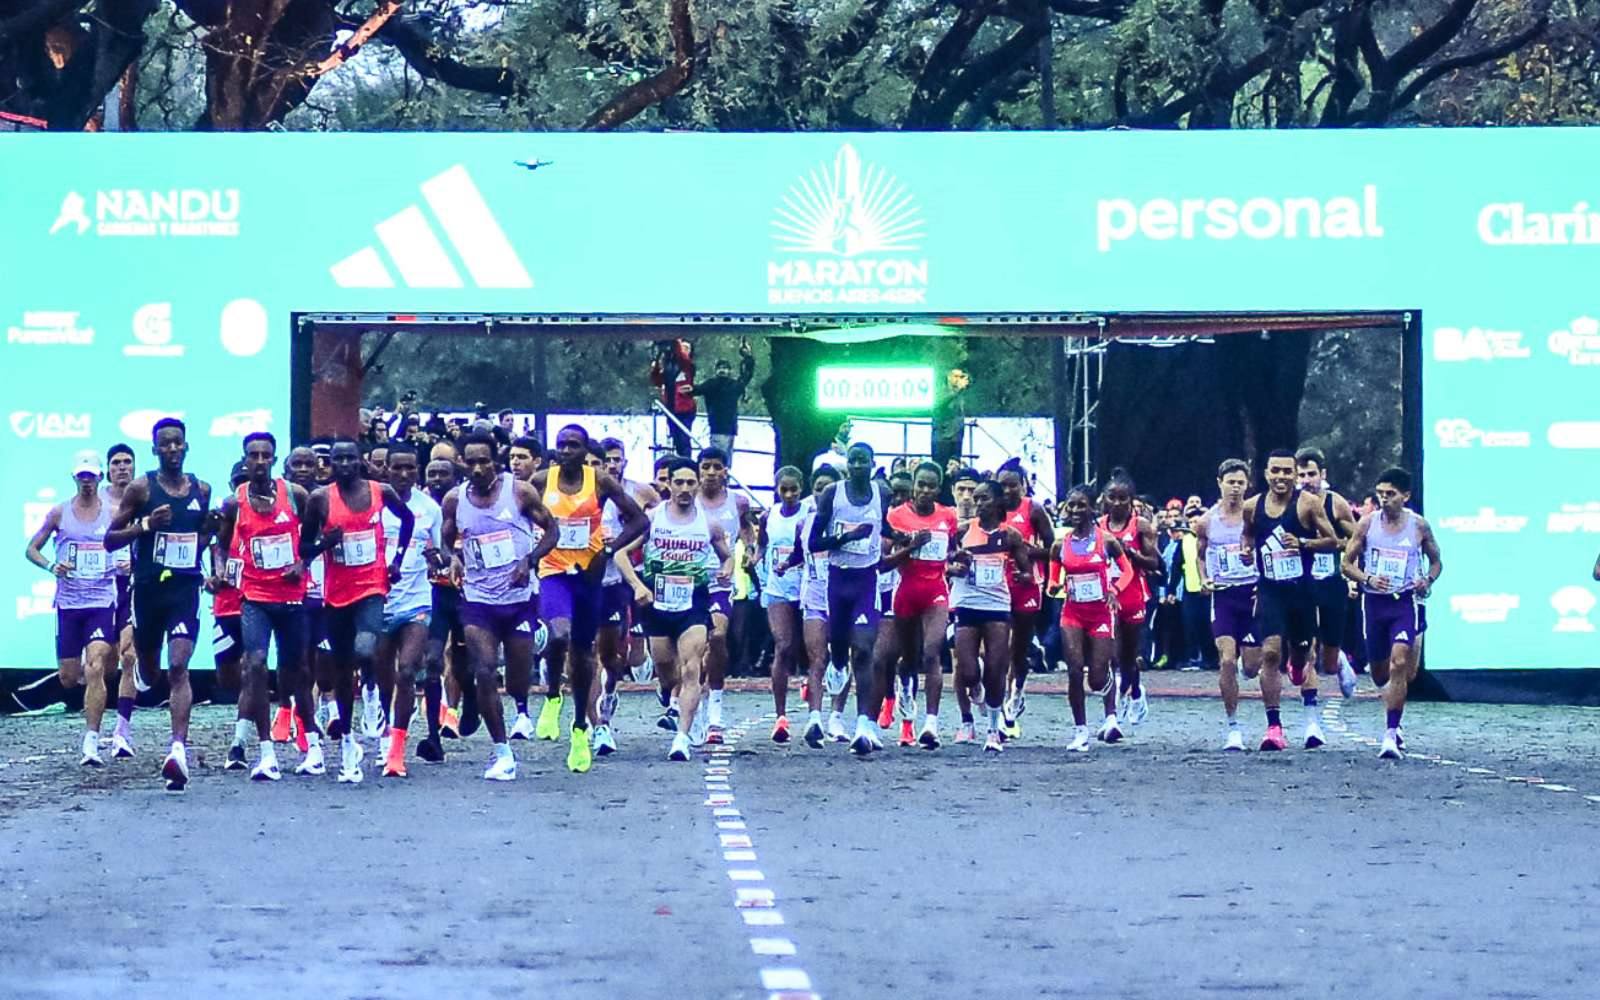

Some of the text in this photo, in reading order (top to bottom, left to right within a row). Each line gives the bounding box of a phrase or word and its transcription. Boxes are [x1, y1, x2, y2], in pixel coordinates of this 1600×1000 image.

[1096, 184, 1383, 252] personal
[767, 259, 928, 287] MARATON
[768, 288, 833, 304] BUENOS
[822, 377, 930, 401] 00:00:09
[570, 530, 577, 542] 2
[356, 544, 363, 557] 9
[654, 538, 705, 551] CHUBUT
[178, 546, 189, 560] 10
[273, 547, 280, 558] 7
[494, 545, 501, 558] 3
